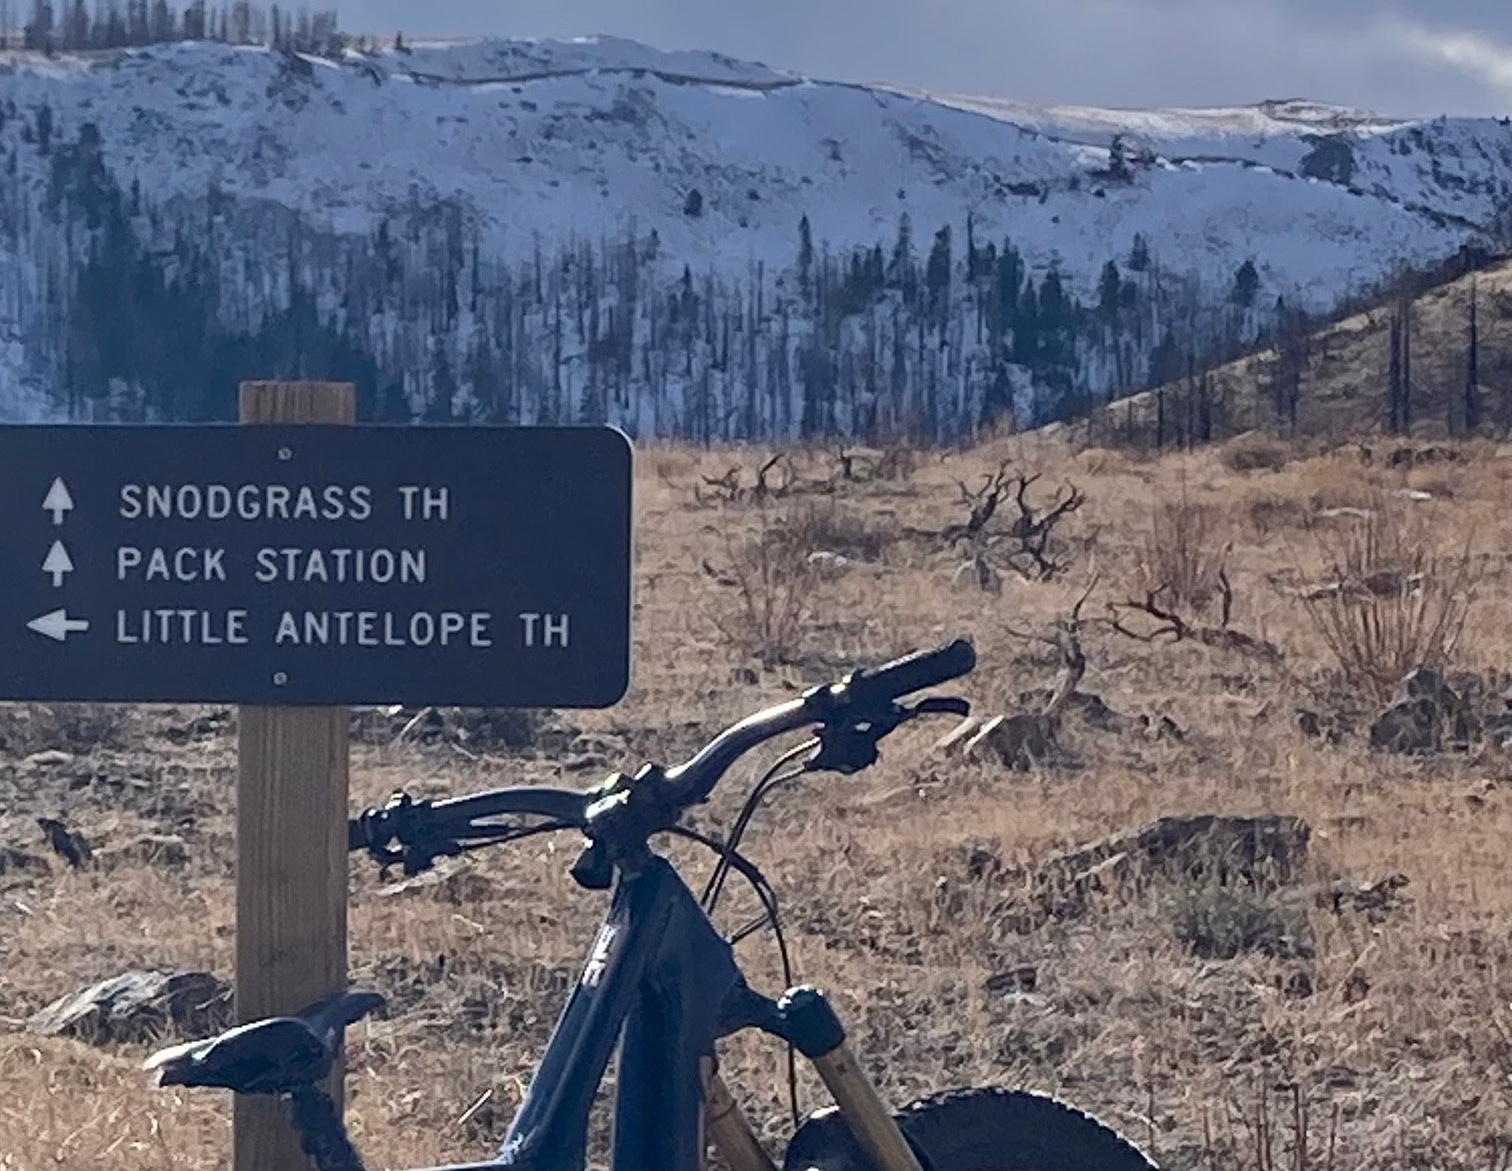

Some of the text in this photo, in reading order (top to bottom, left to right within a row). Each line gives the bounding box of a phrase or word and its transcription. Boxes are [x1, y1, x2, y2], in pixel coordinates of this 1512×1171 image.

[119, 483, 449, 521] SNODGRASS TH
[117, 546, 426, 583] PACK STATION
[117, 608, 570, 647] LITTLE ANTELOPE TH
